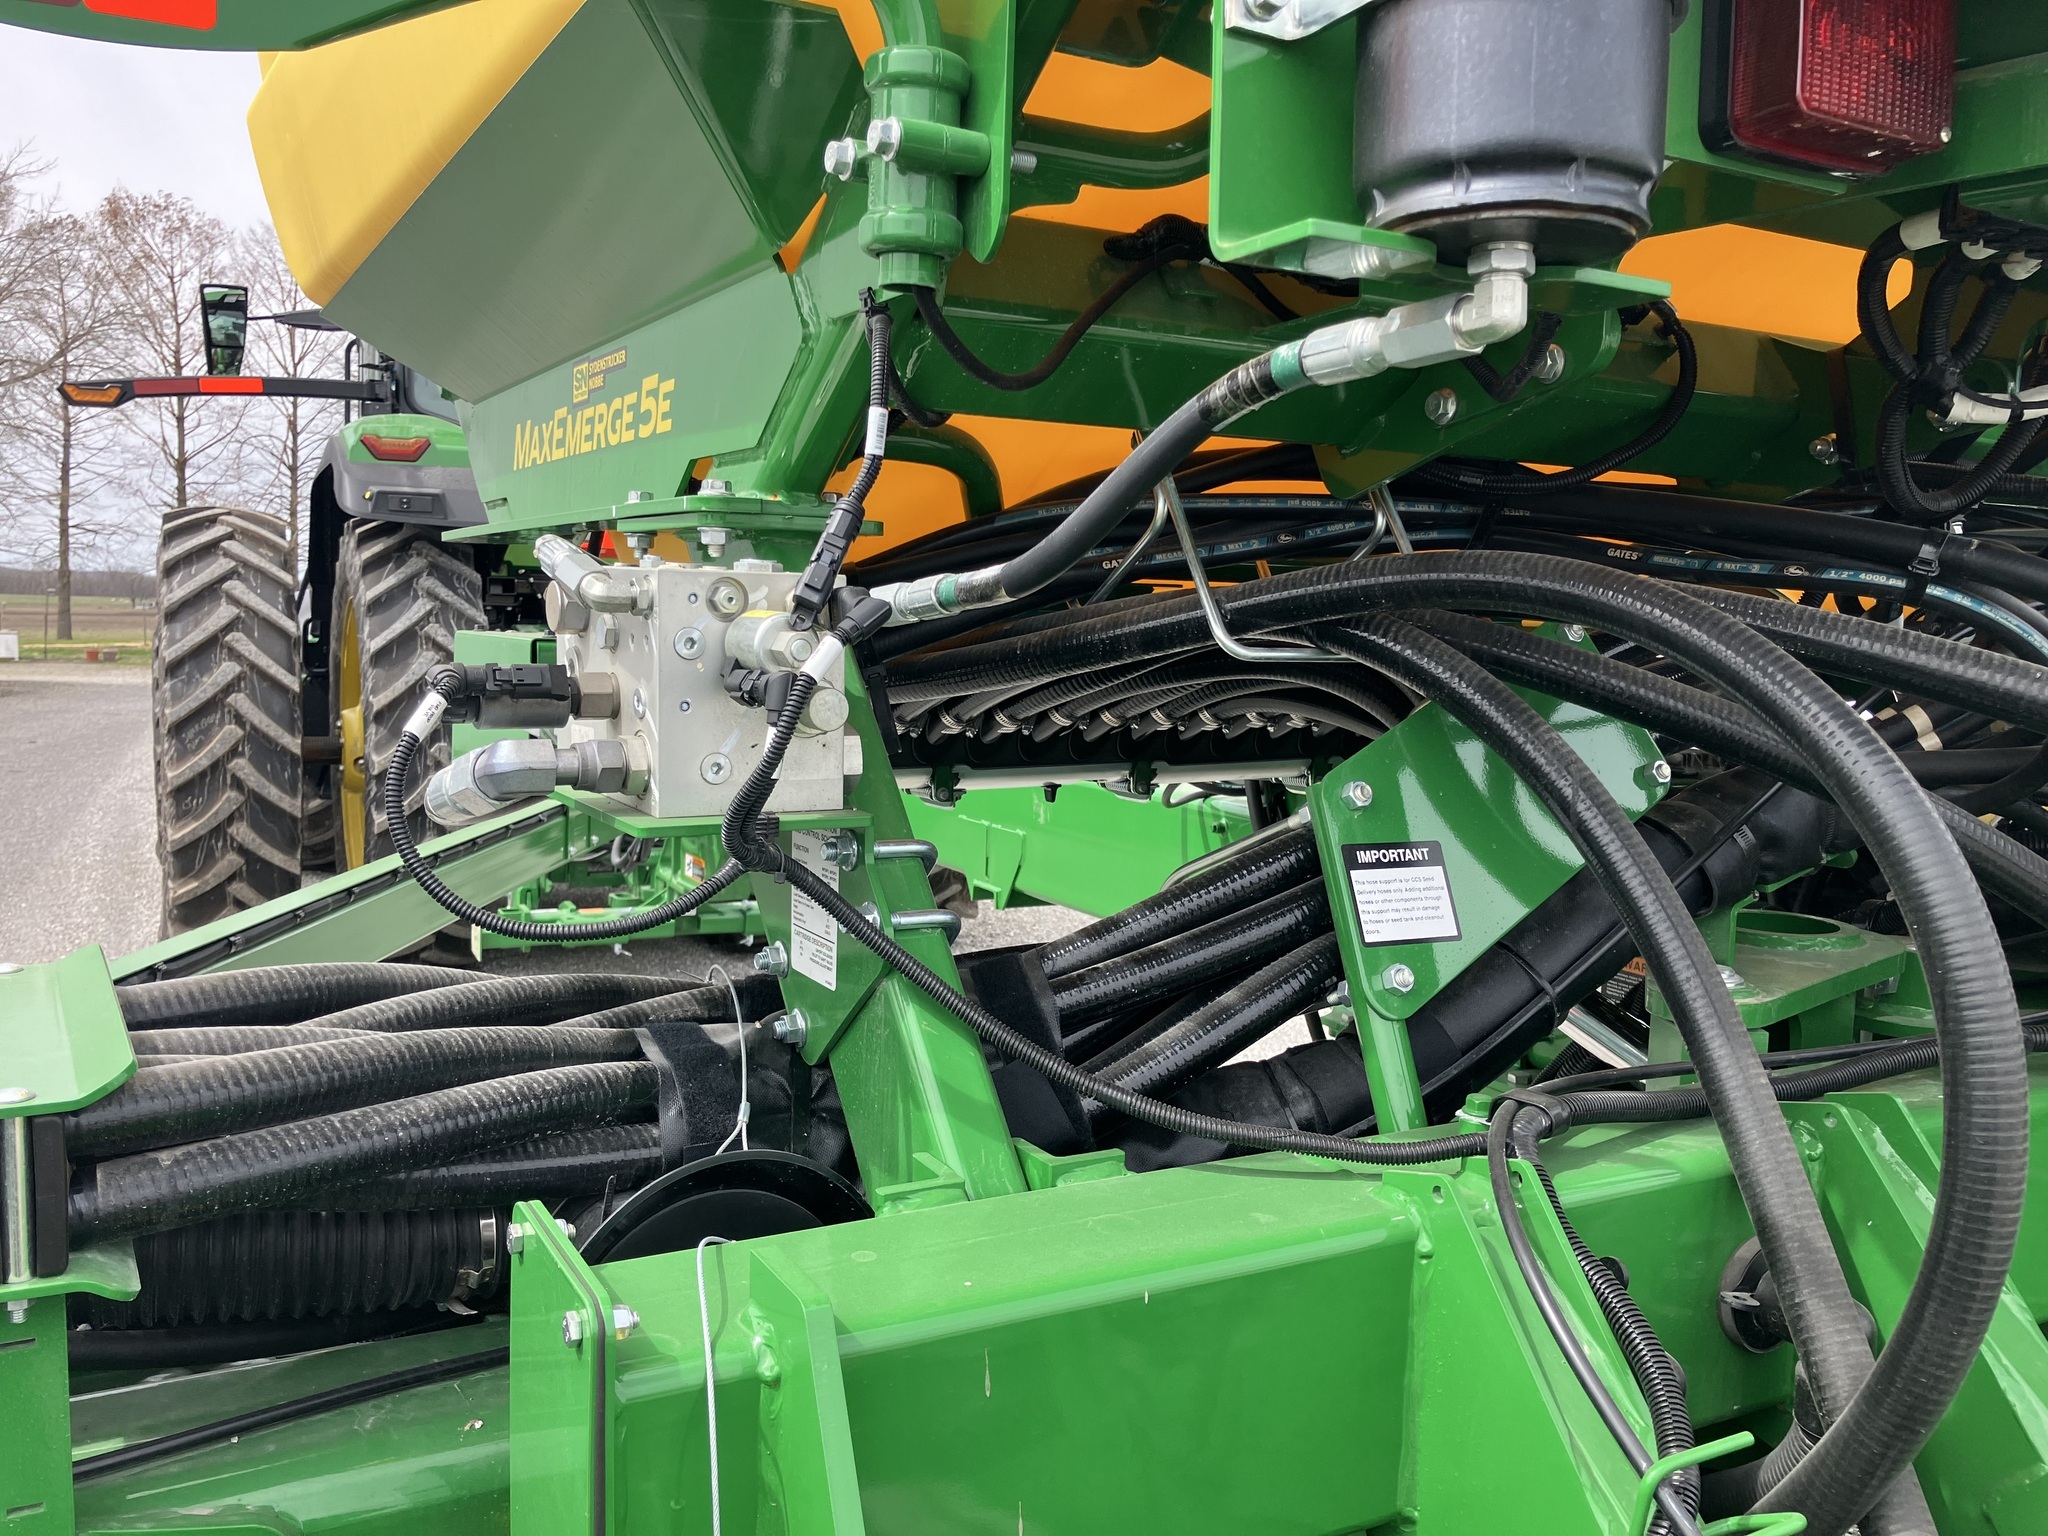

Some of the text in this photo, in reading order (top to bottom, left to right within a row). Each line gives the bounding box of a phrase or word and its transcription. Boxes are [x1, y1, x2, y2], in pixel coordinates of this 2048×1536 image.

[638, 373, 675, 439] 5E
[1326, 523, 1343, 532] 4000
[1344, 522, 1356, 531] psi
[1829, 570, 1854, 578] 1/2"
[1858, 572, 1887, 583] 4000
[1888, 577, 1906, 586] psi
[1356, 848, 1429, 864] IMPORTANT
